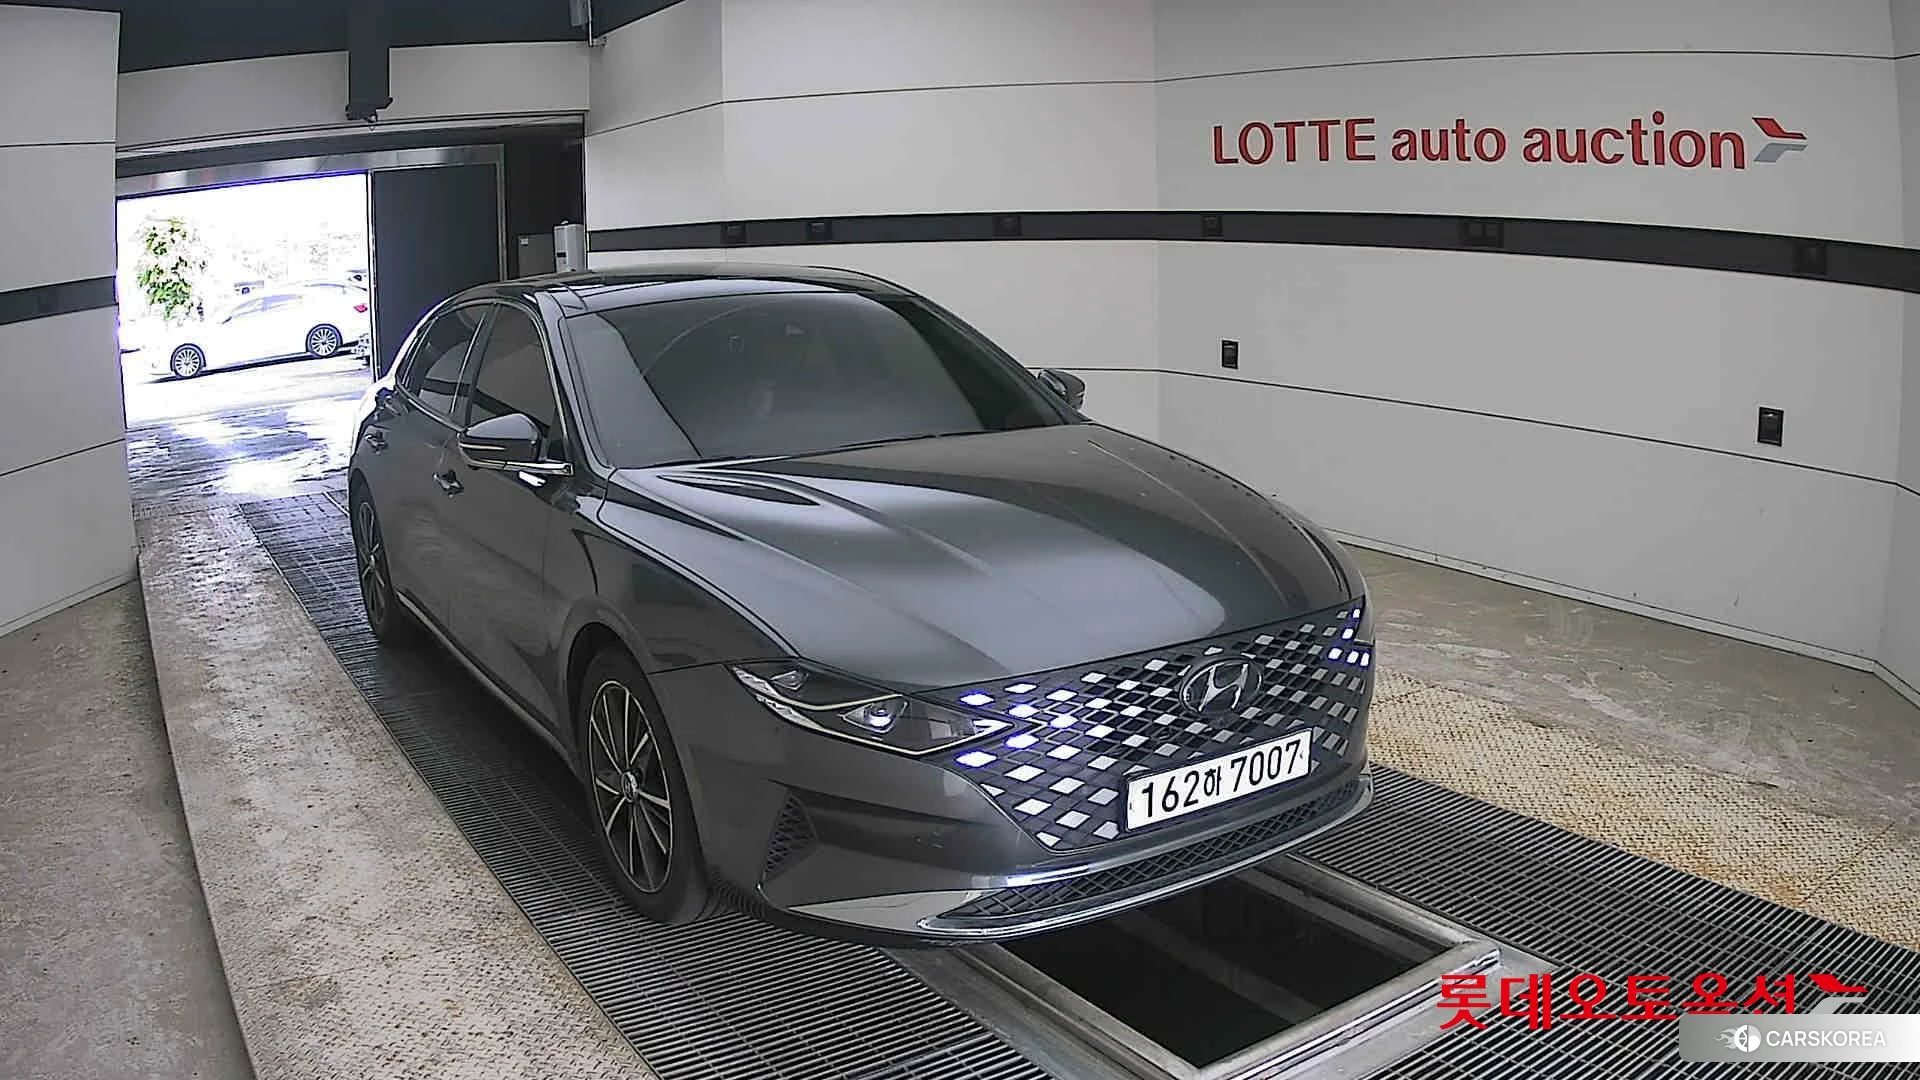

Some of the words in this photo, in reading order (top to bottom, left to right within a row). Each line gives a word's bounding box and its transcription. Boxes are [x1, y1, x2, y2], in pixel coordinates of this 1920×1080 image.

[1213, 118, 1376, 164] LOTTE
[1391, 118, 1507, 163] auto
[1522, 111, 1746, 169] auction
[1142, 765, 1222, 818] 162하
[1230, 739, 1301, 793] 7007
